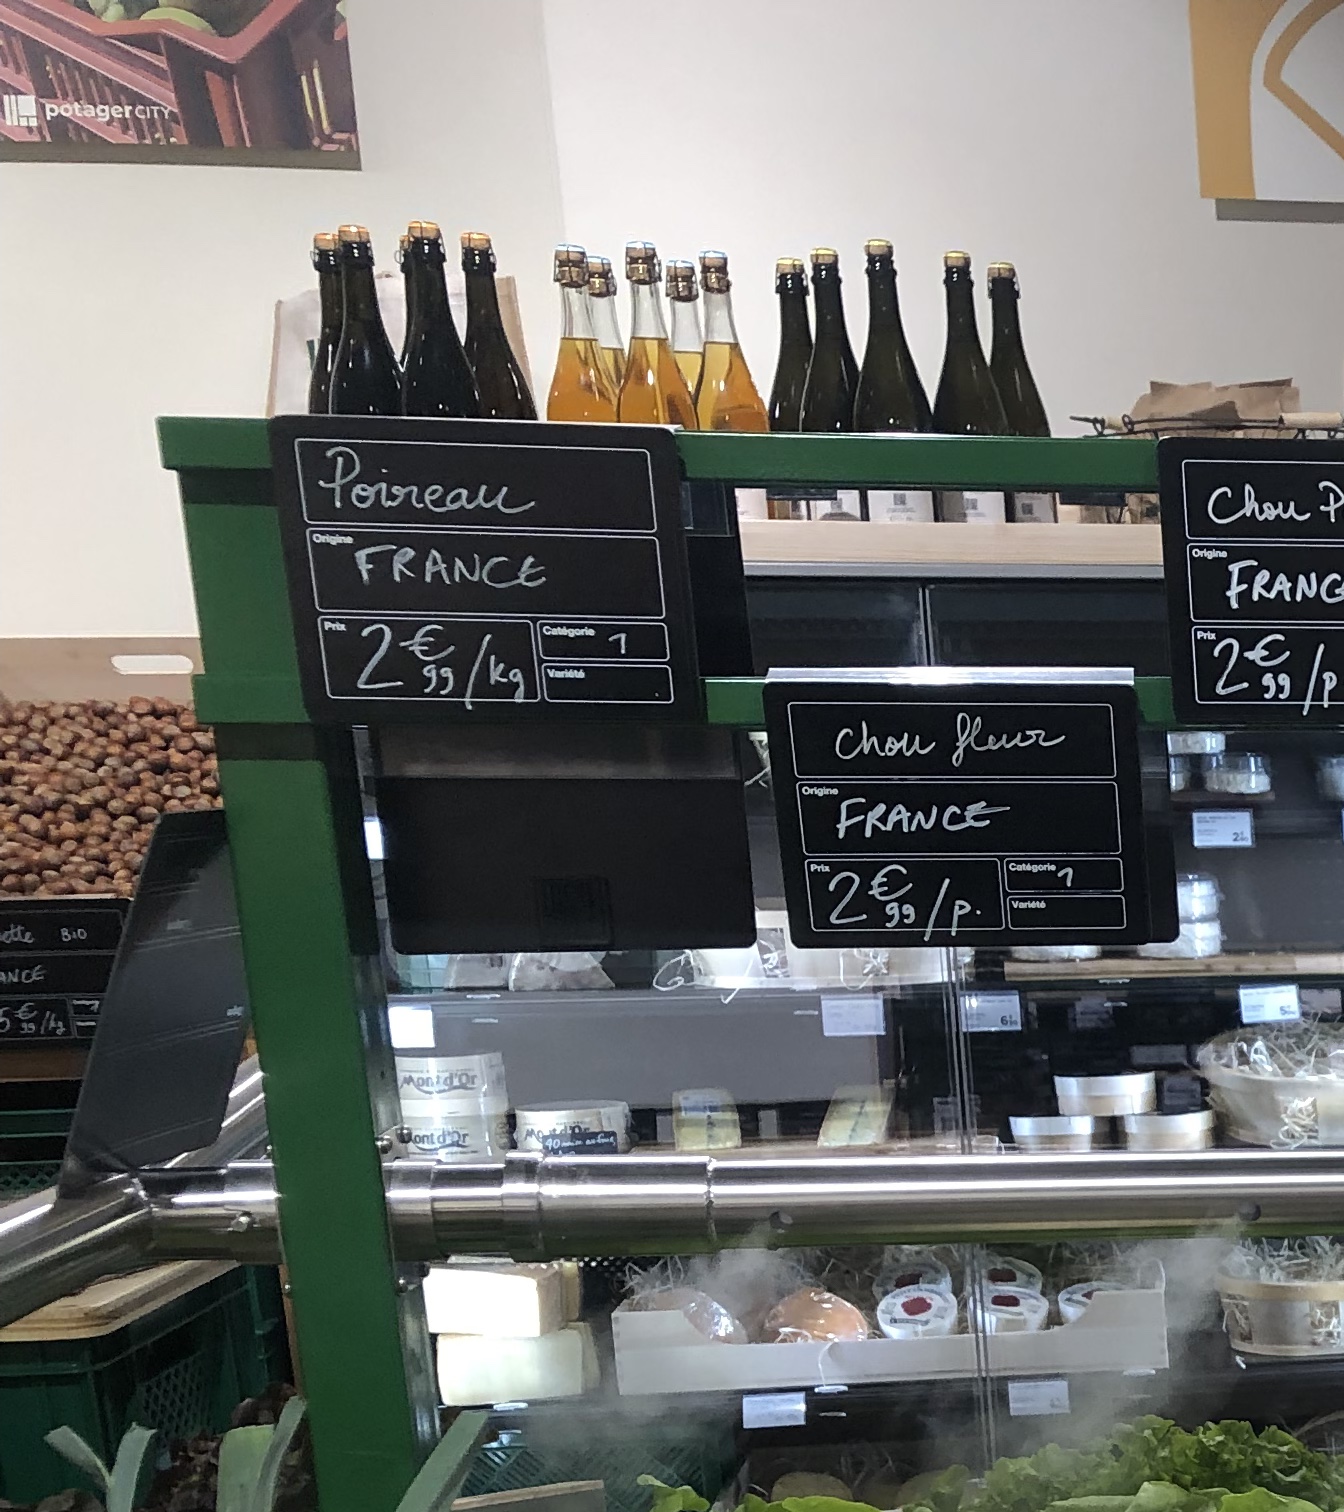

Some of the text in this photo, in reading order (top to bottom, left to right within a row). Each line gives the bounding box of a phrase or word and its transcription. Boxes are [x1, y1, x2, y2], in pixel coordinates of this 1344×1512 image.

[45, 101, 170, 121] potagerCITY
[319, 447, 535, 513] Poireau
[1208, 484, 1311, 524] Chou
[312, 533, 353, 545] Origine
[1192, 549, 1227, 558] Origine
[355, 545, 546, 588] FRANCE
[324, 622, 346, 632] Prix
[543, 625, 627, 654] Catégorie 1
[1197, 631, 1216, 640] Prix
[546, 668, 585, 679] Variété
[952, 712, 1066, 767] fleur
[802, 786, 838, 796] Origine
[836, 798, 1010, 839] FRANCE
[810, 864, 830, 873] Prix
[1009, 862, 1073, 887] Catégorie 1
[1011, 900, 1046, 910] Variété
